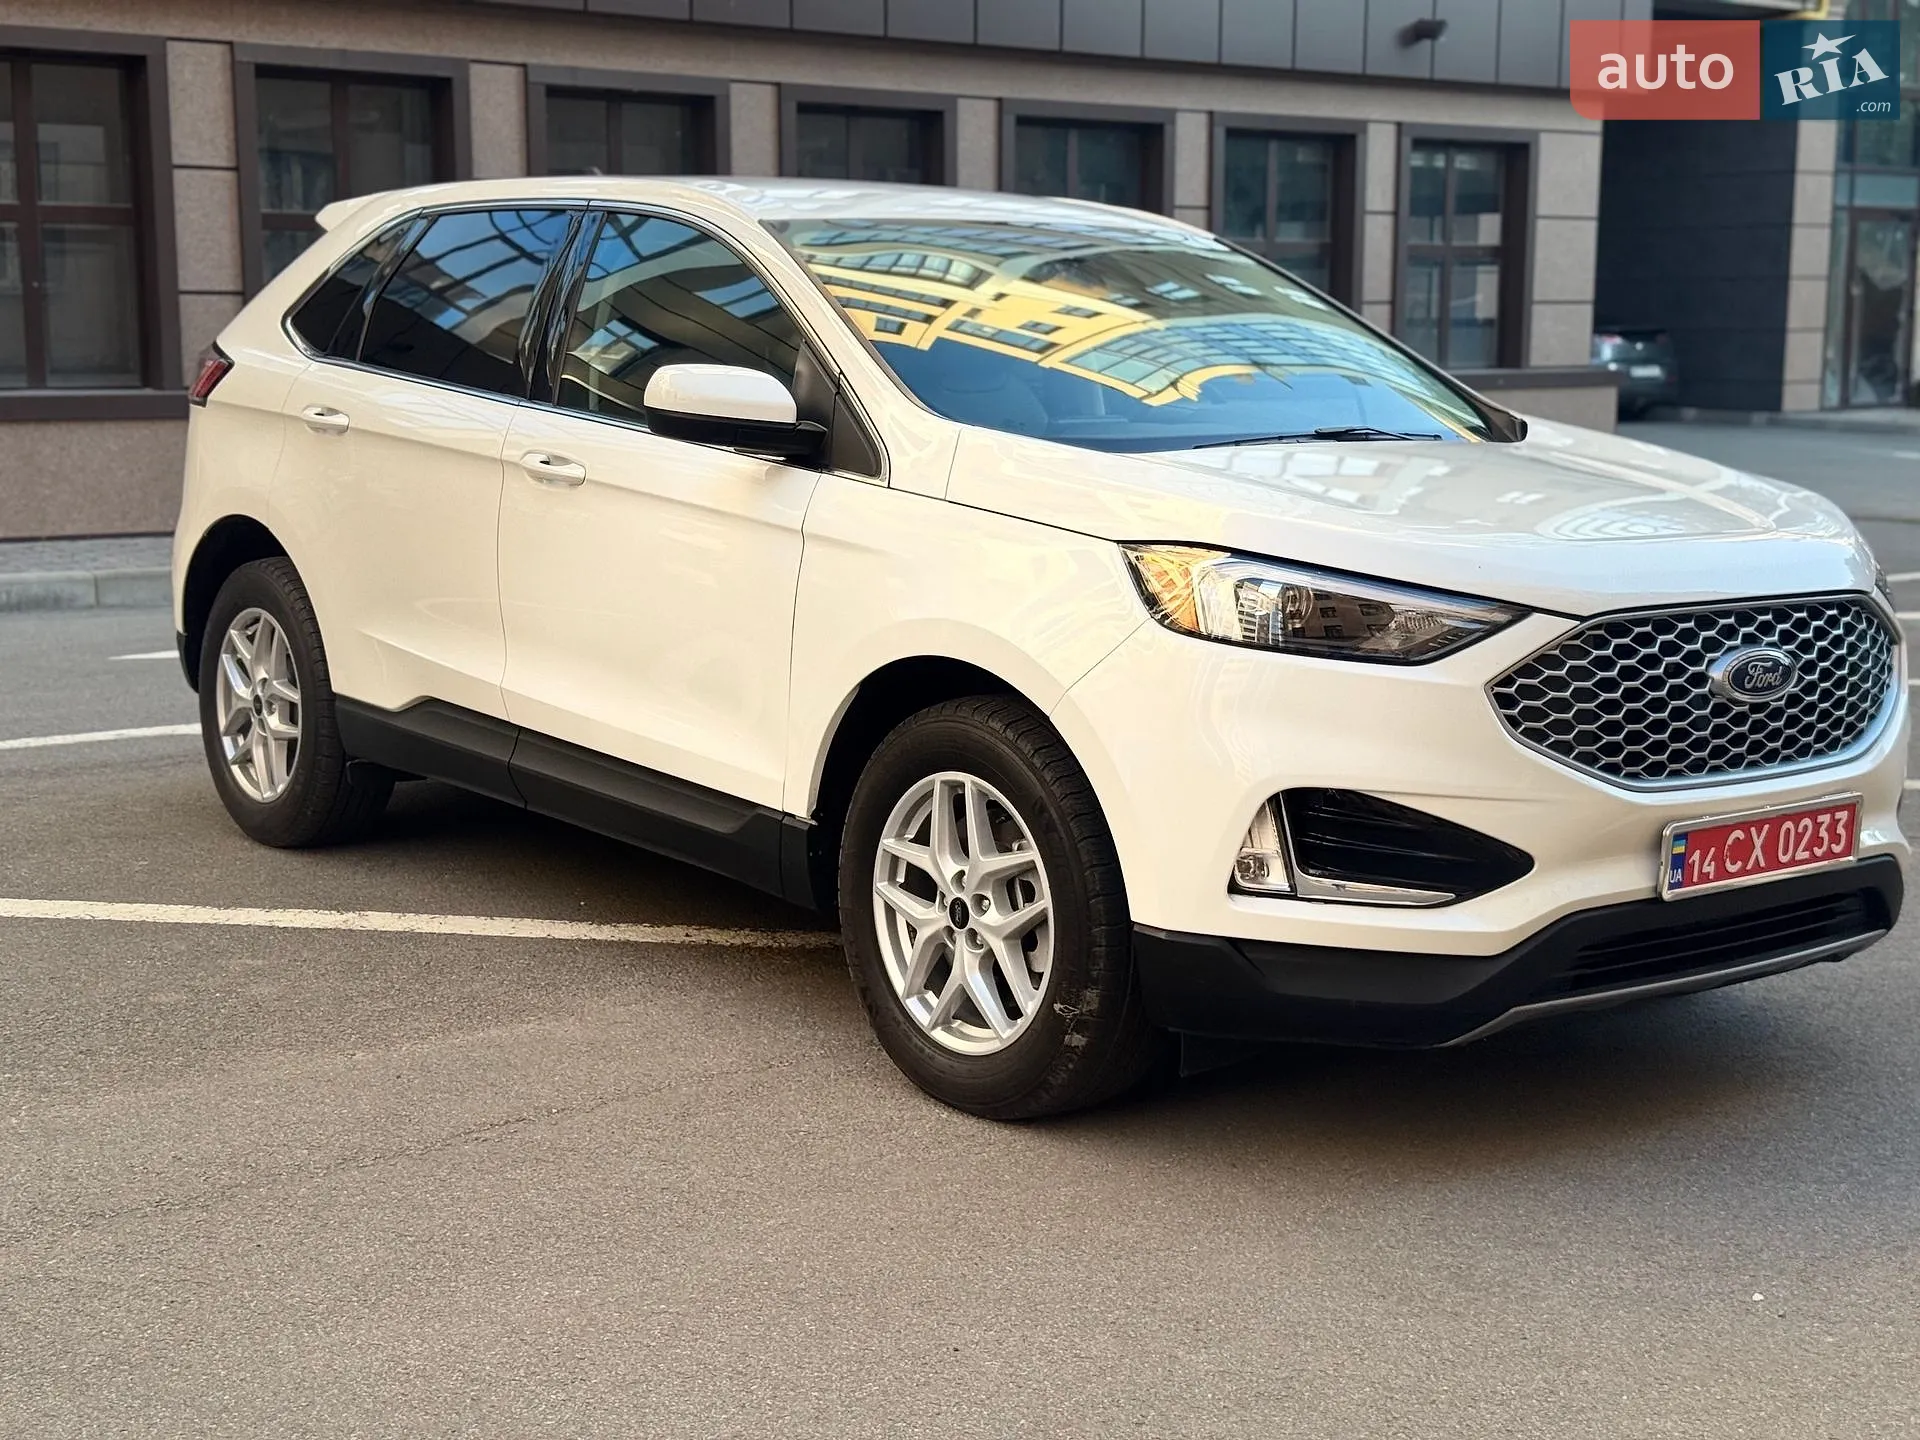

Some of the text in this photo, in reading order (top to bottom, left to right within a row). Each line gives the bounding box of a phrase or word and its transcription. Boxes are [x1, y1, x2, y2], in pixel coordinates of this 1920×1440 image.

[1744, 661, 1782, 689] Ford
[1688, 810, 1849, 882] 14 CX 0233
[1669, 868, 1682, 883] UA
